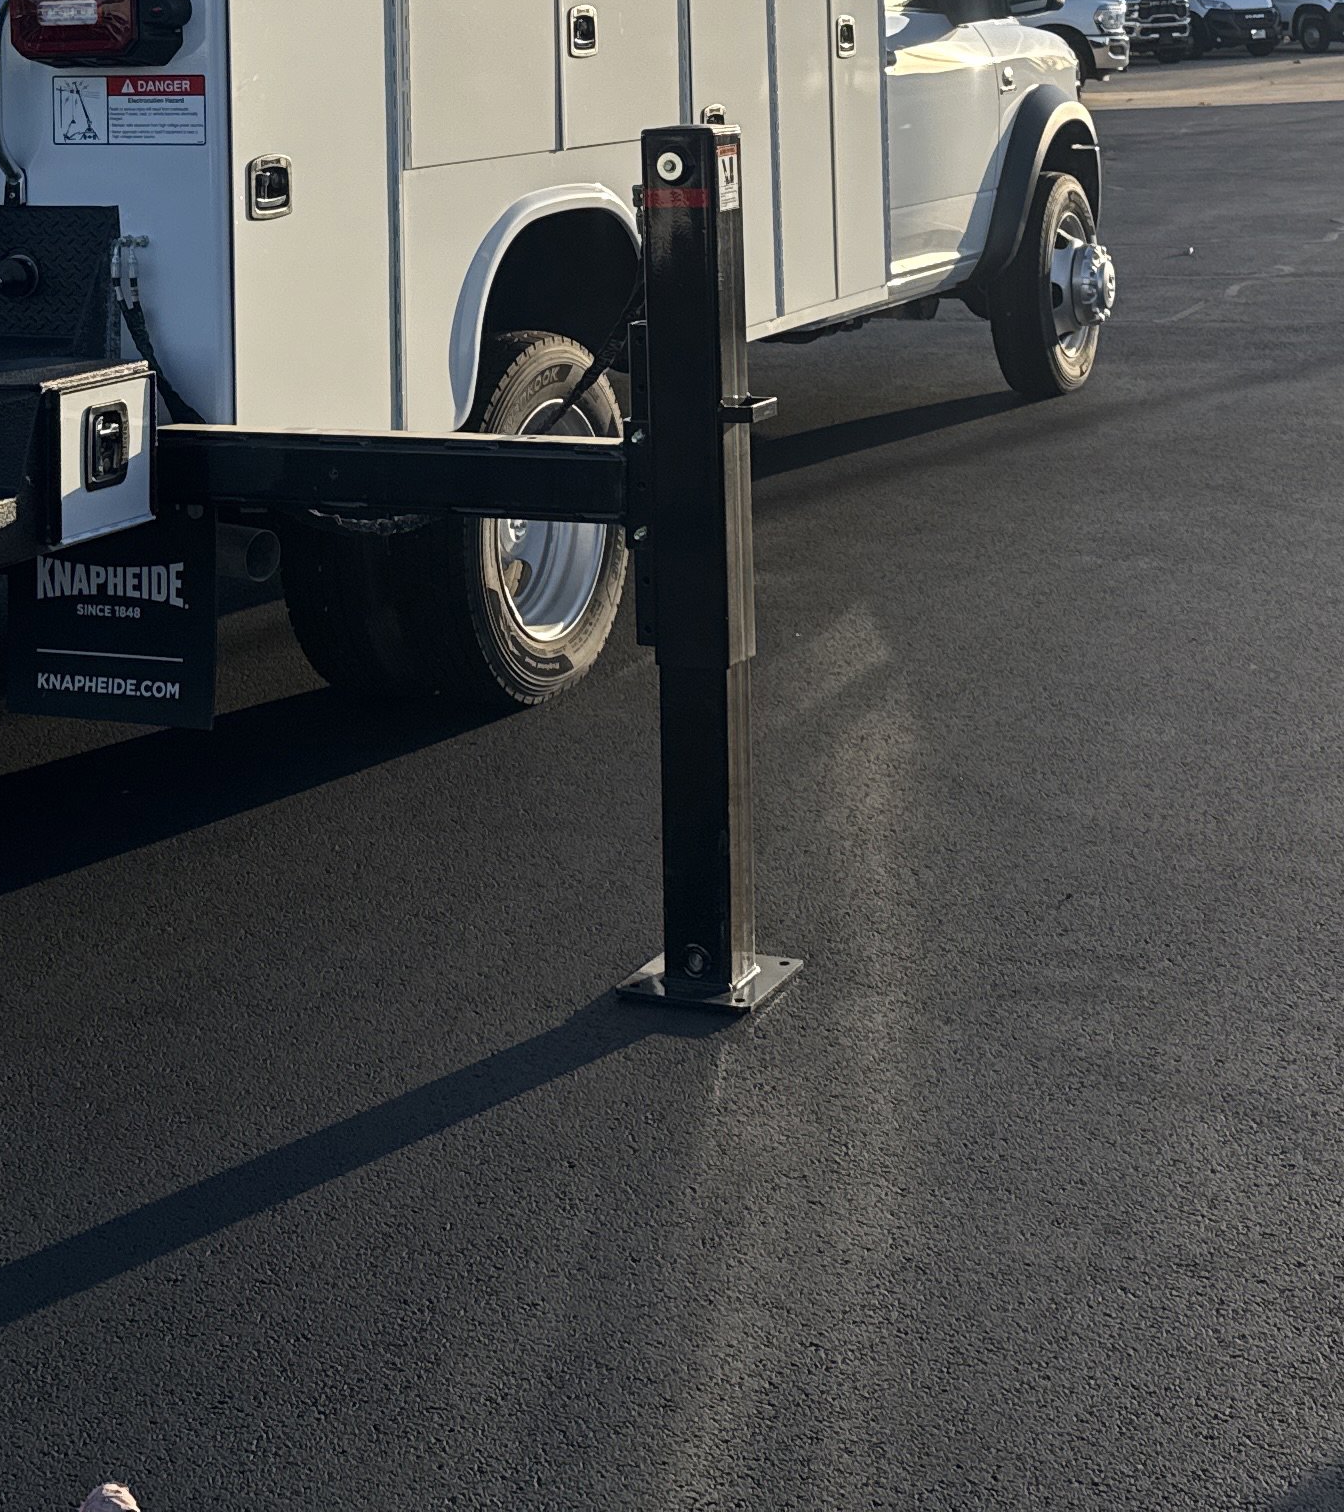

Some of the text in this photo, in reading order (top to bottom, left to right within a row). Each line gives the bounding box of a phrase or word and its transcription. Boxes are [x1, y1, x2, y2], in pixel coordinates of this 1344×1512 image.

[137, 80, 191, 92] DANGER
[36, 555, 185, 609] KNAPHEIDE
[76, 603, 141, 619] SINCE 1848
[36, 672, 181, 700] KNAPHEIDE.COM
